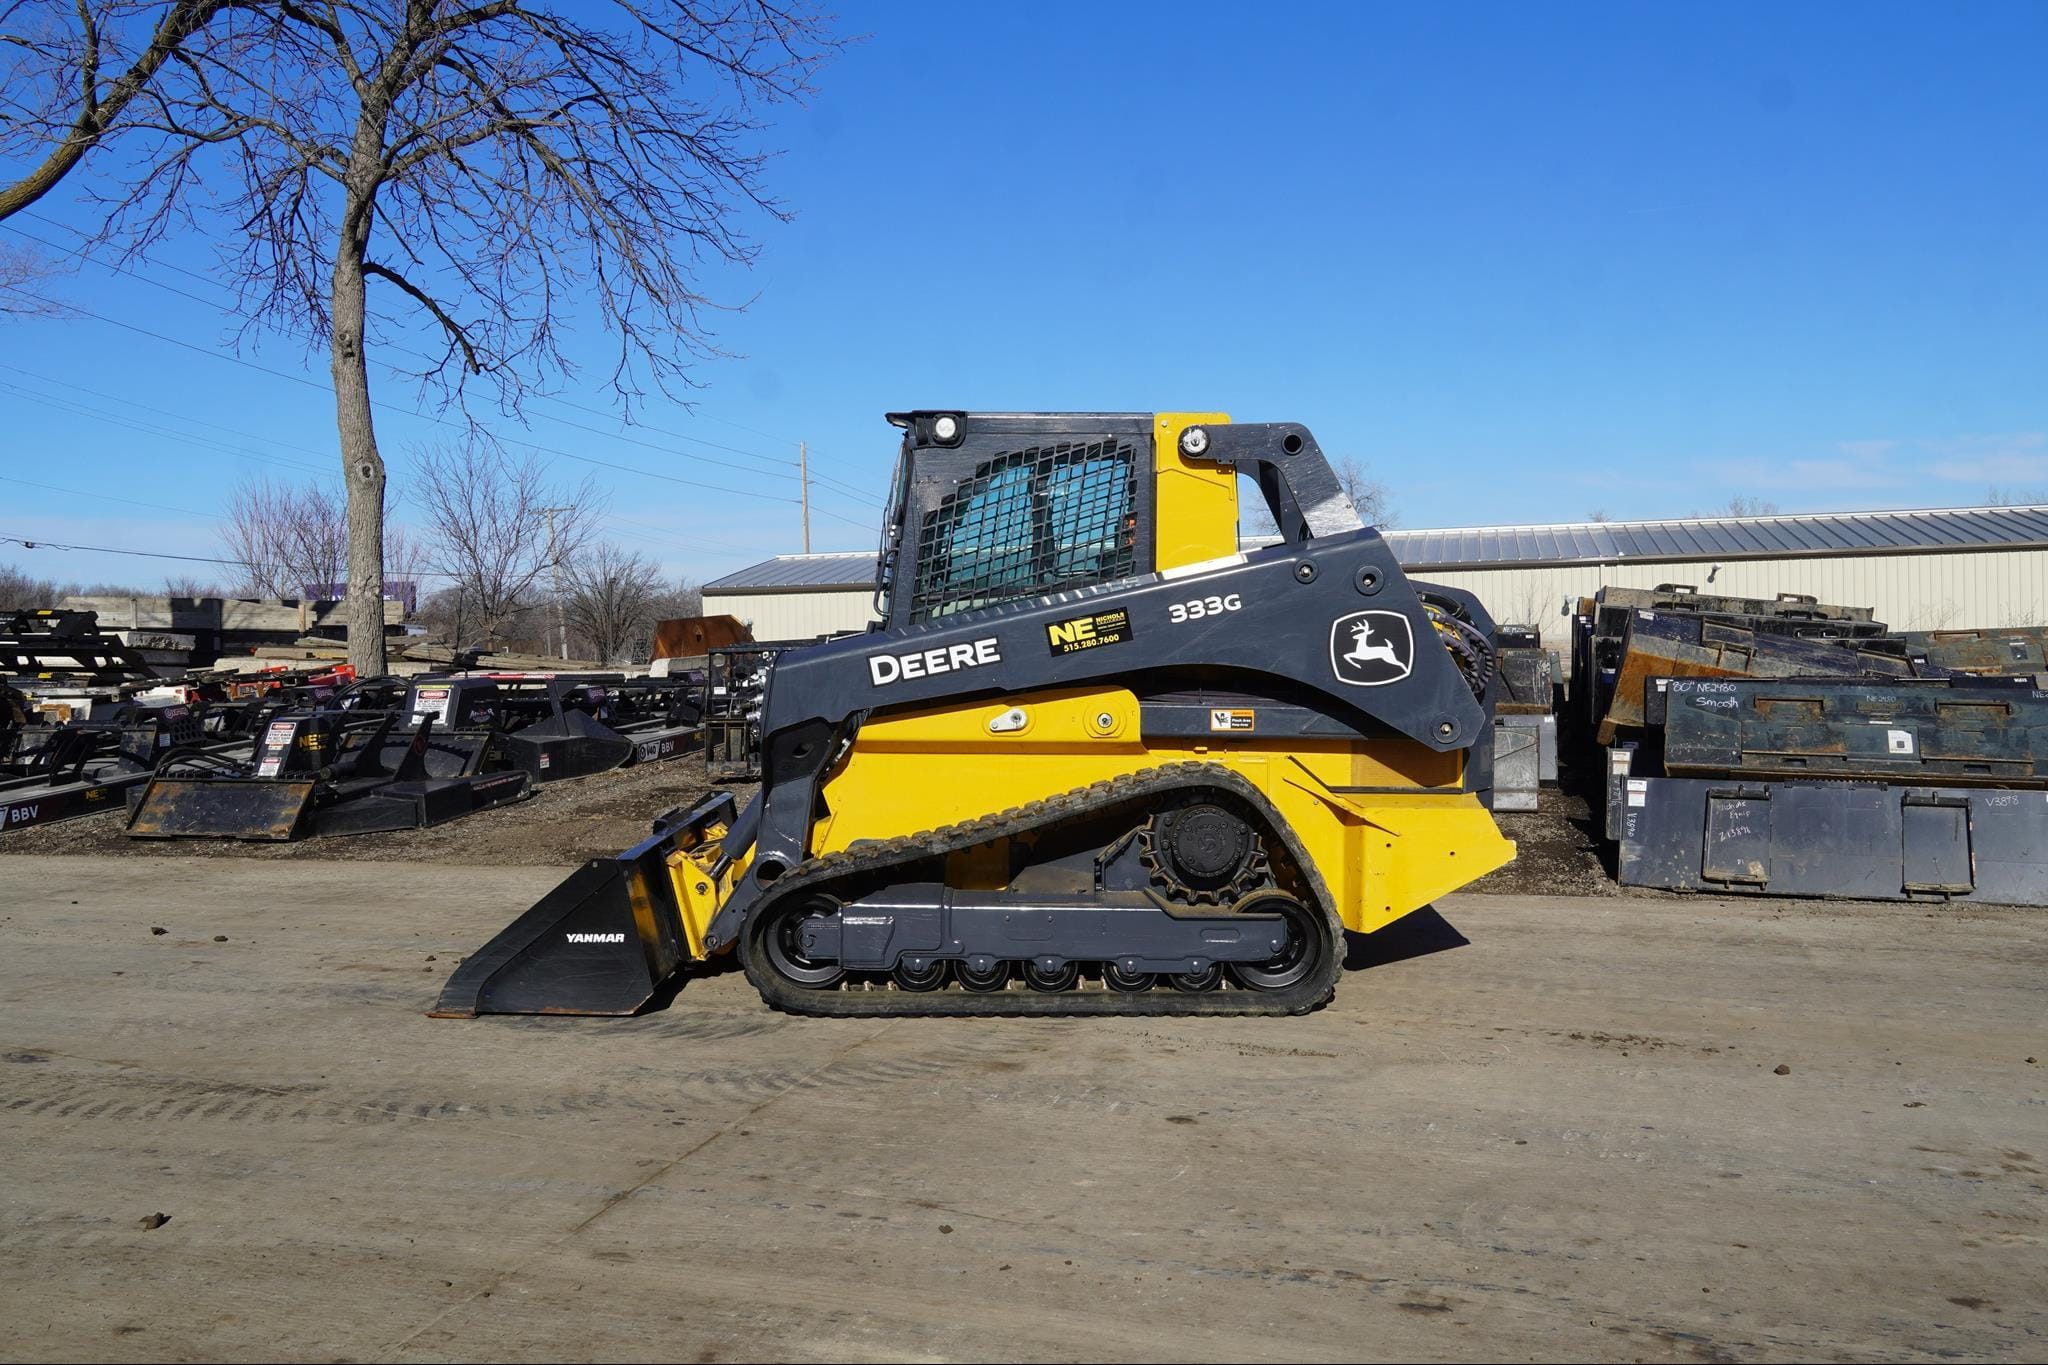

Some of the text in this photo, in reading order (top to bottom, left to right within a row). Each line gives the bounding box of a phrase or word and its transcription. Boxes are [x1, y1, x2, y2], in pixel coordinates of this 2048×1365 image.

[1095, 612, 1125, 622] NICHOLS
[1168, 594, 1242, 623] 333G
[1048, 617, 1096, 646] NE
[1063, 634, 1120, 652] 515.280.7600
[869, 637, 1001, 686] DEERE
[661, 741, 675, 753] BBV
[11, 804, 39, 822] BBV
[566, 933, 625, 943] YANMAR
